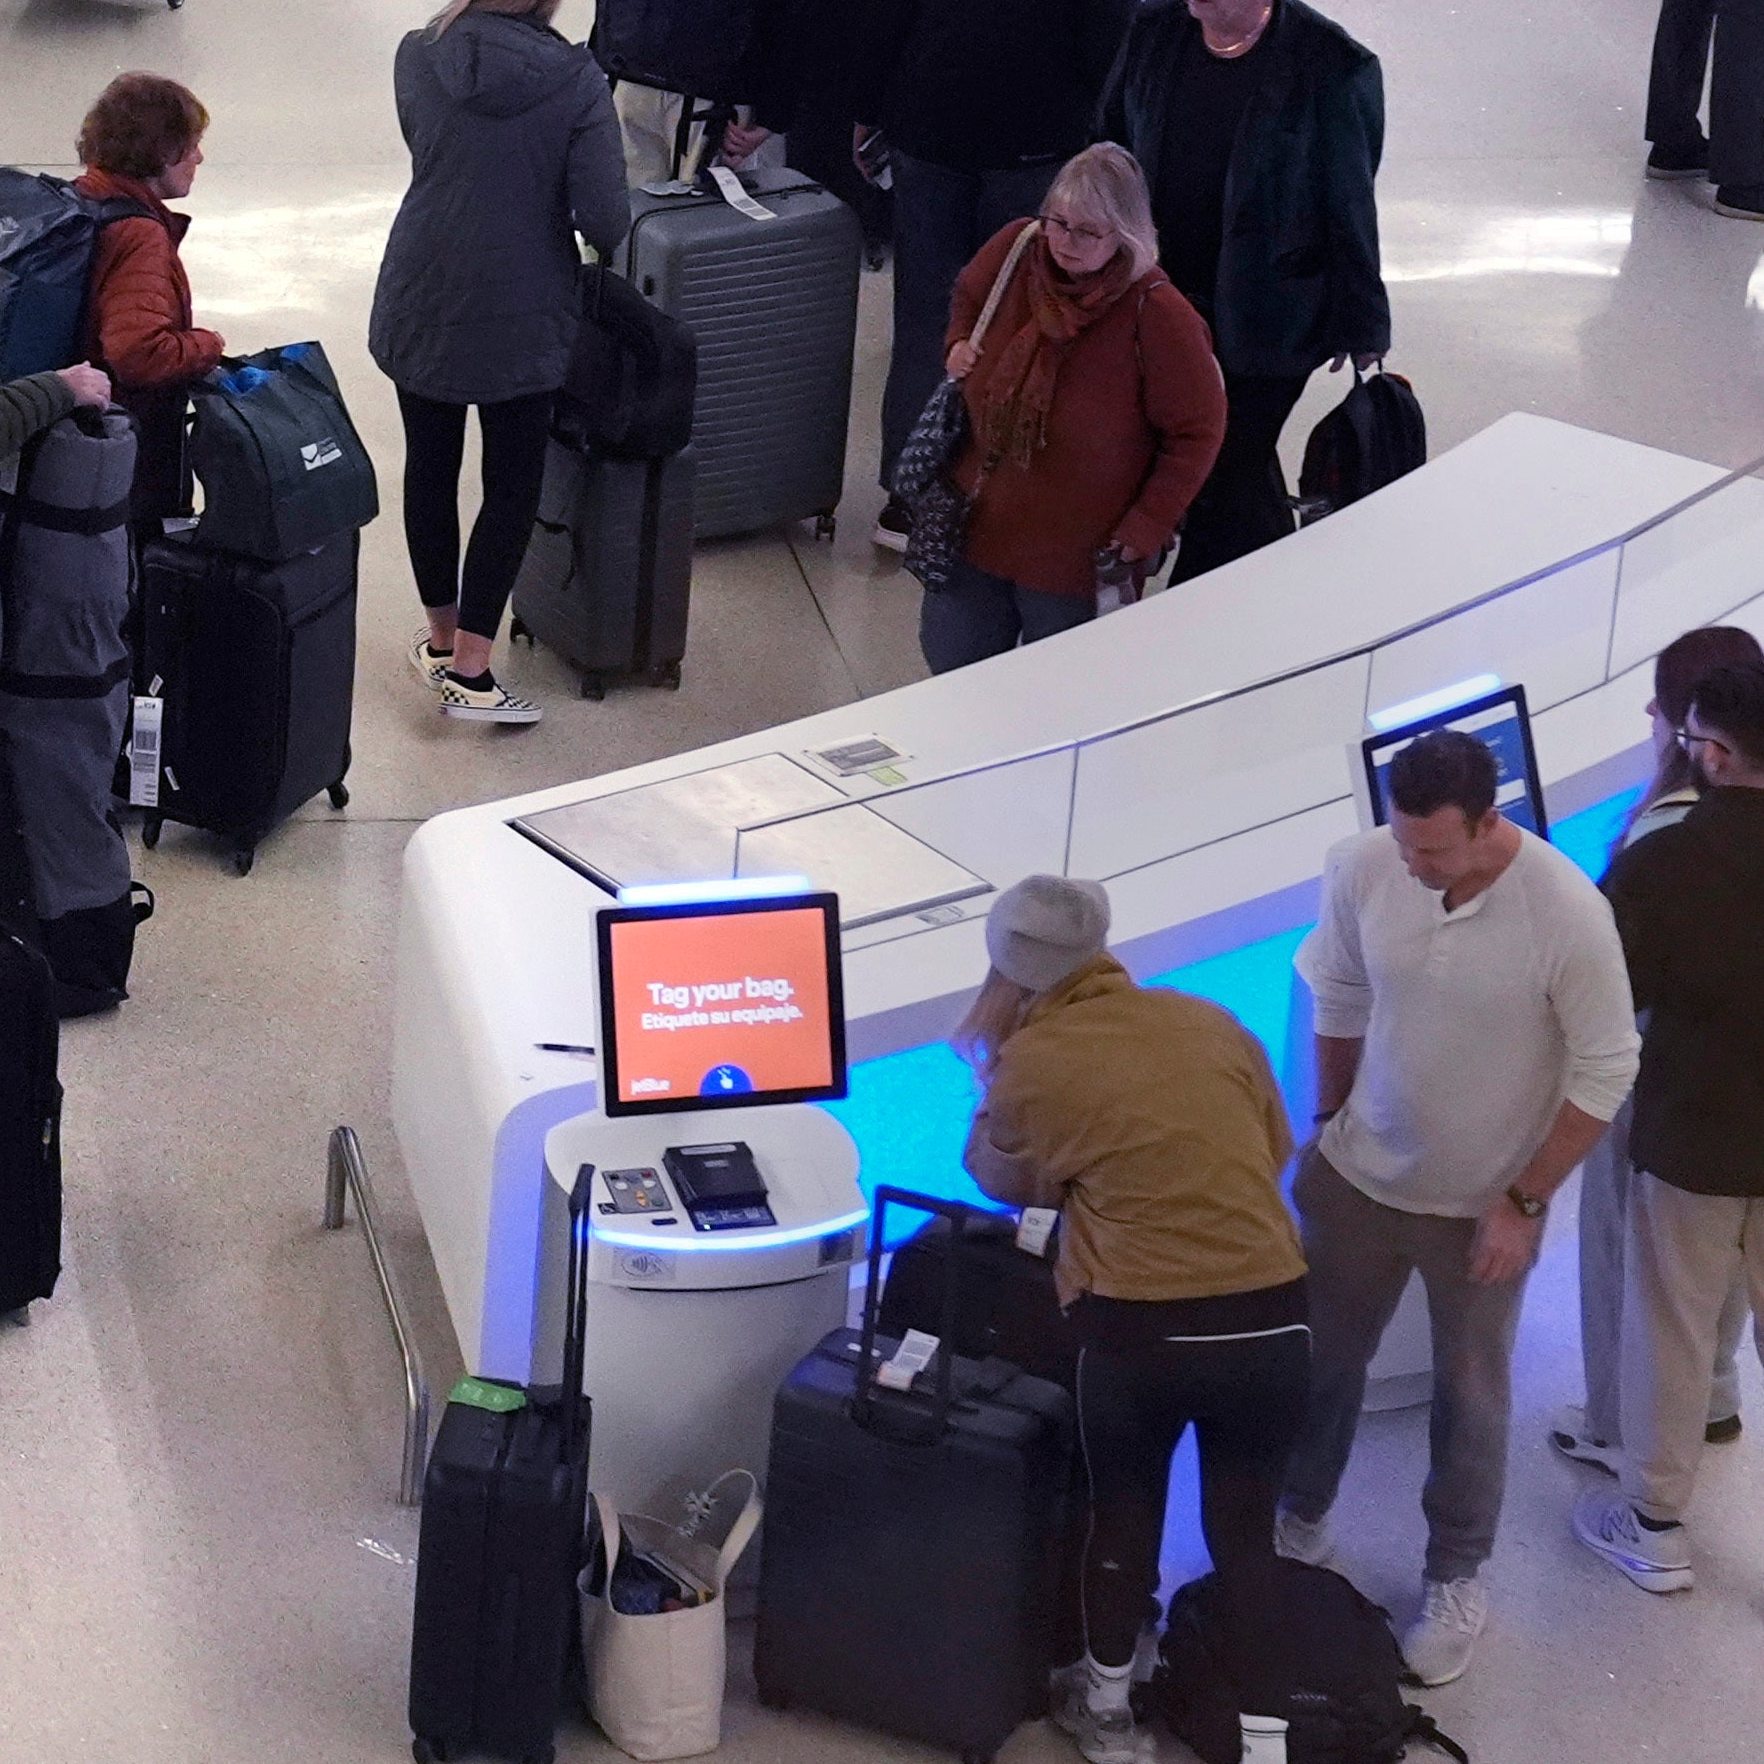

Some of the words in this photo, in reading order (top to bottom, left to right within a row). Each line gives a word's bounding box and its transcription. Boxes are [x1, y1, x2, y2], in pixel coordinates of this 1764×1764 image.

[647, 983, 690, 1008] Tag
[693, 983, 742, 1007] your
[745, 976, 795, 1001] bag.
[641, 1011, 709, 1031] Etiquete
[710, 1012, 730, 1024] su
